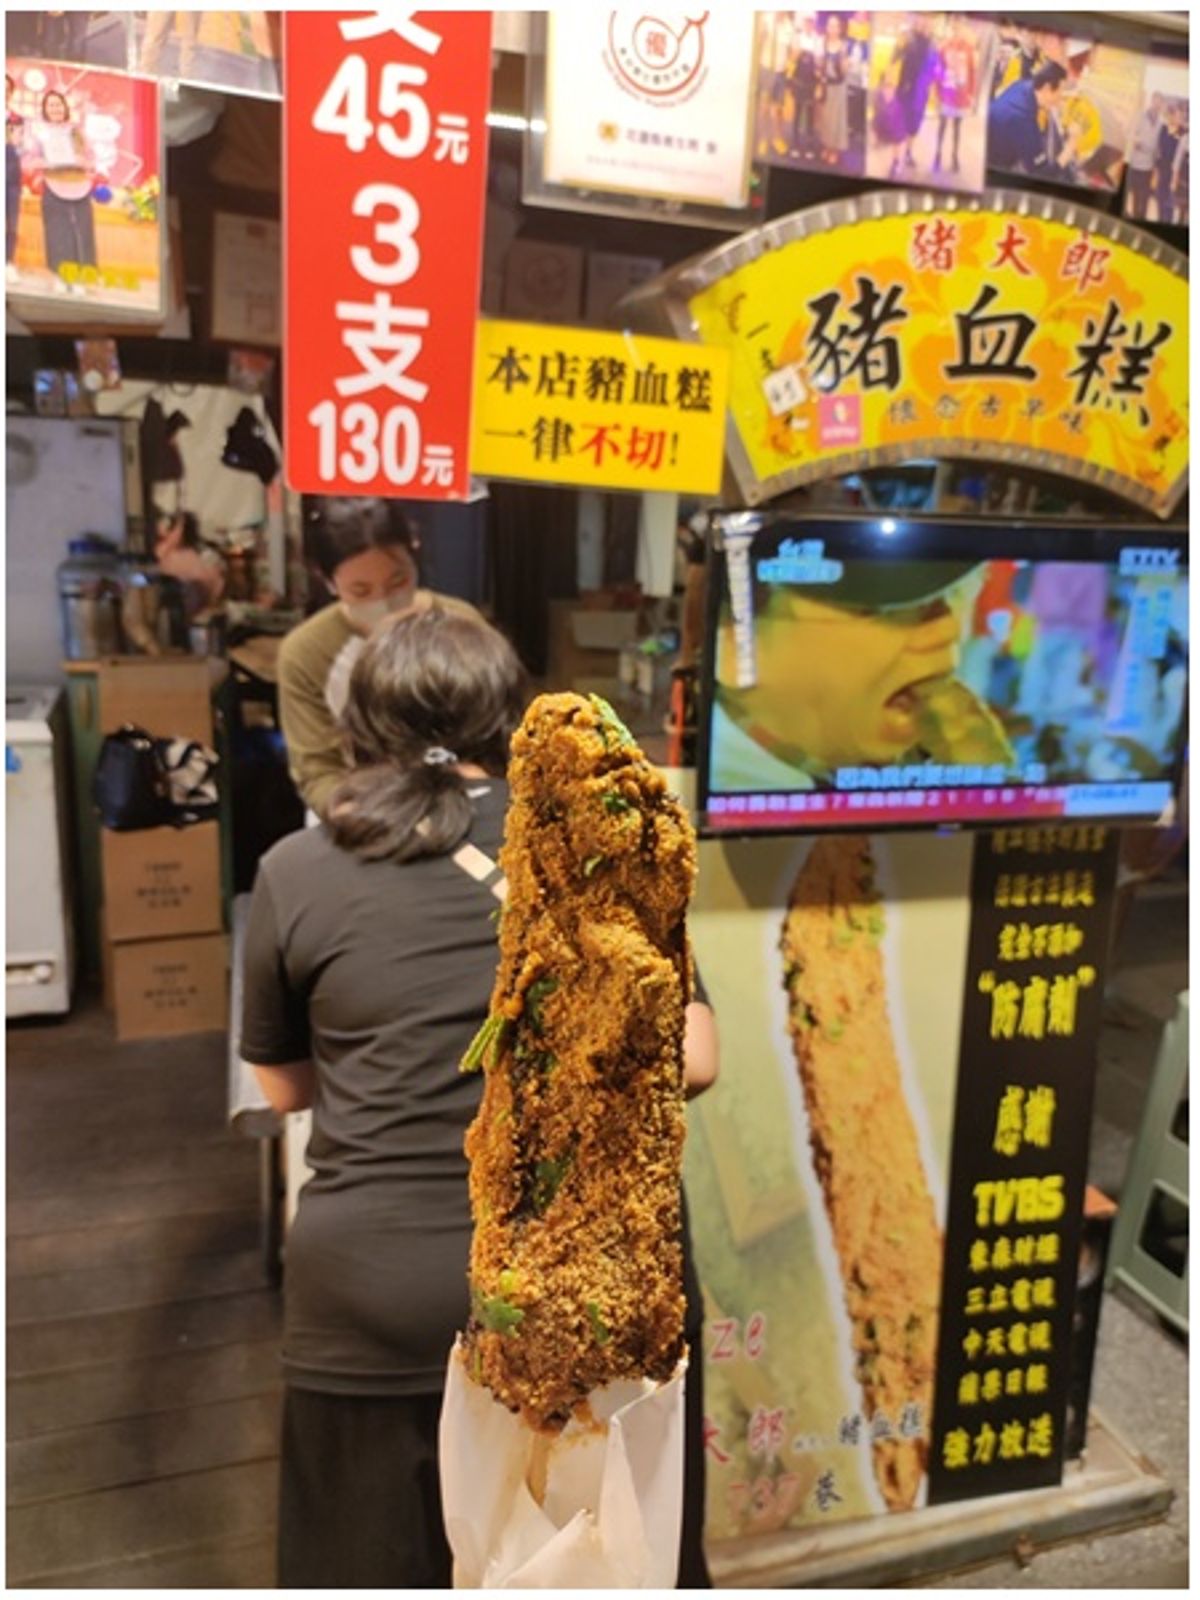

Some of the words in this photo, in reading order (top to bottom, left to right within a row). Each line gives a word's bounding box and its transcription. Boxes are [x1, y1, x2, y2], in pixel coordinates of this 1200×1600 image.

[311, 53, 470, 164] 45元
[350, 183, 421, 286] 3
[910, 219, 1112, 292] 豬大郎
[486, 346, 712, 413] 本店豬血糕
[805, 276, 1173, 428] 豬血糕
[308, 400, 454, 486] 130元
[973, 1174, 1065, 1227] TVBS
